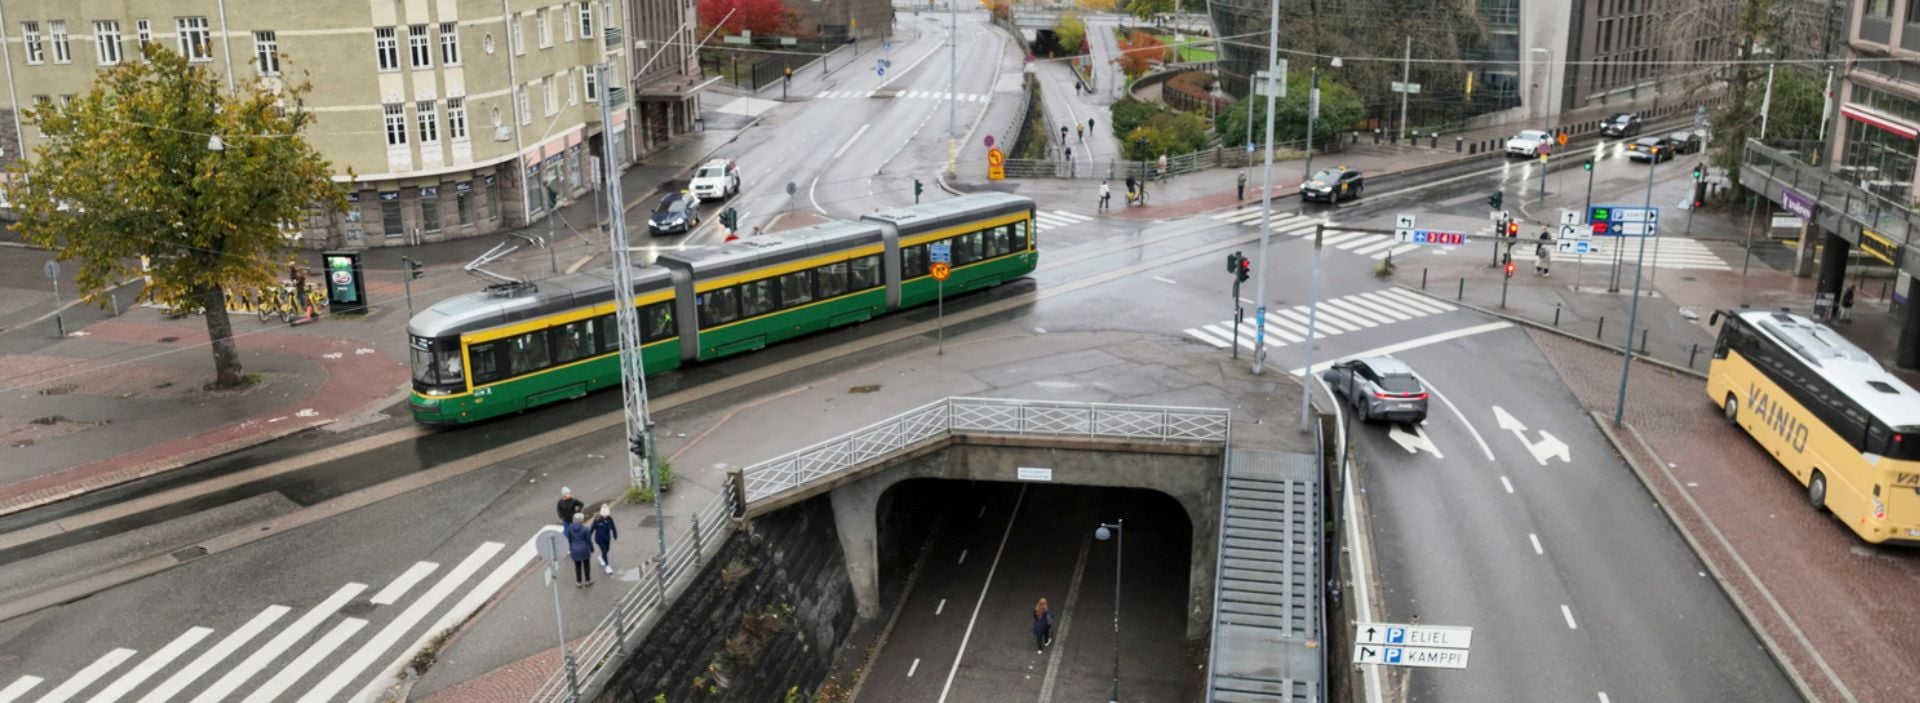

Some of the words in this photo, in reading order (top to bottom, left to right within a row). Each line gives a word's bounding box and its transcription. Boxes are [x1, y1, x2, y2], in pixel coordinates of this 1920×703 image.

[1748, 383, 1808, 454] VAINIO
[1390, 628, 1402, 642] P
[1411, 630, 1448, 644] ELIEL
[1386, 649, 1399, 662] P
[1408, 651, 1461, 665] KAMPPI
